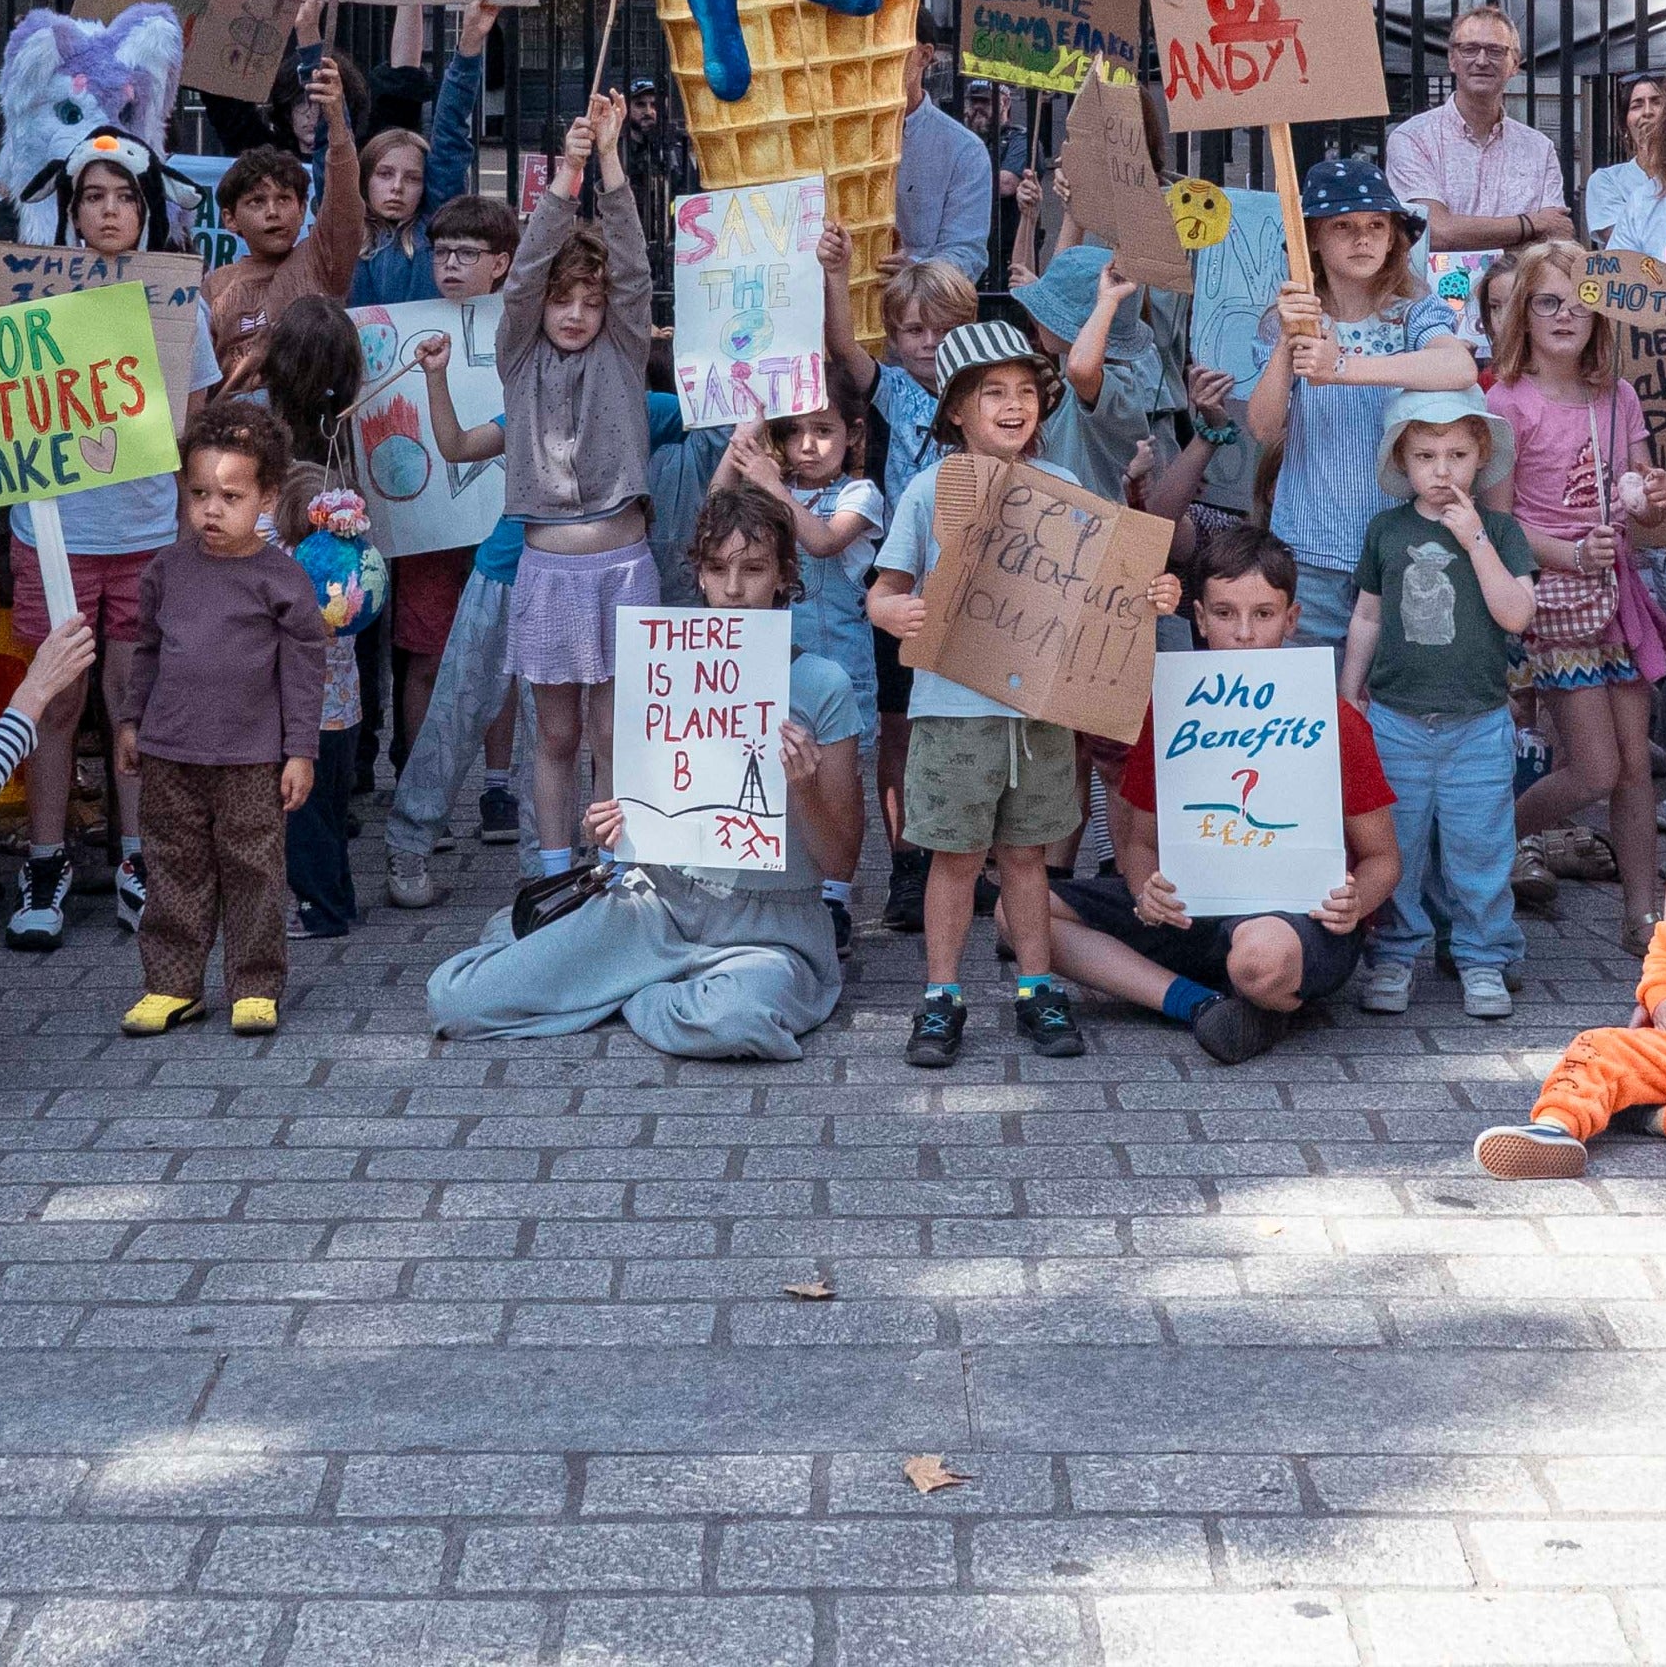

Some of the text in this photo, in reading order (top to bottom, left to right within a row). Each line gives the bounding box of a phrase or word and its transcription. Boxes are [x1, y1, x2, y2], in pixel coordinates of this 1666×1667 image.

[1164, 34, 1310, 102] ANDY!
[675, 184, 826, 266] SAVE
[1, 252, 135, 283] WHEAT
[1585, 253, 1622, 276] I'M
[697, 263, 792, 313] THE
[676, 351, 823, 423] EARTH
[638, 616, 745, 652] THERE
[646, 658, 740, 698] IS NO
[1184, 672, 1276, 711] Who
[644, 700, 776, 743] PLANET
[1164, 715, 1327, 761] Benefits
[672, 750, 693, 792] B
